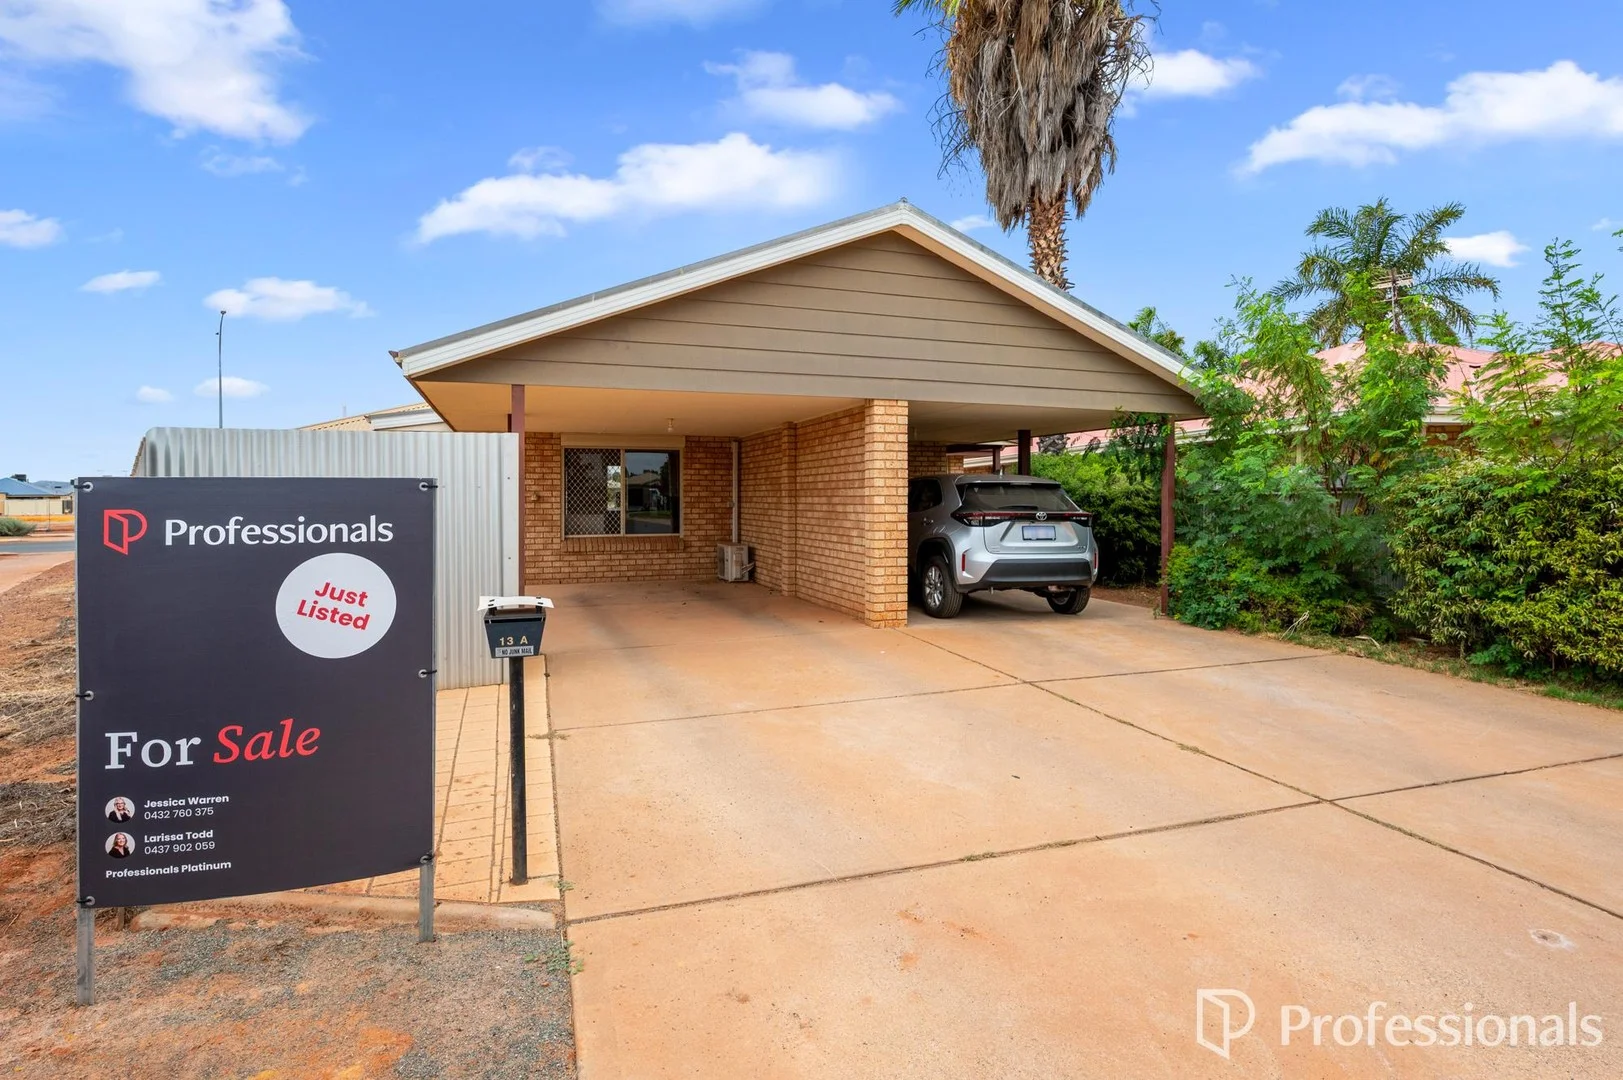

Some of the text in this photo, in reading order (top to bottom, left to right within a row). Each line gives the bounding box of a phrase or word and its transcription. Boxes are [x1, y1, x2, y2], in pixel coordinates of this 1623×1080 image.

[165, 515, 393, 546] Professionals
[314, 582, 369, 607] Just
[296, 599, 370, 631] Listed
[499, 635, 528, 646] 13 A
[104, 718, 321, 770] For Sale
[144, 794, 229, 808] Jessica Warren
[144, 807, 214, 820] 0432 760 375
[144, 829, 213, 843] Larissa Todd
[144, 841, 215, 855] 0437 902 059
[106, 860, 231, 879] Professionals Platinum
